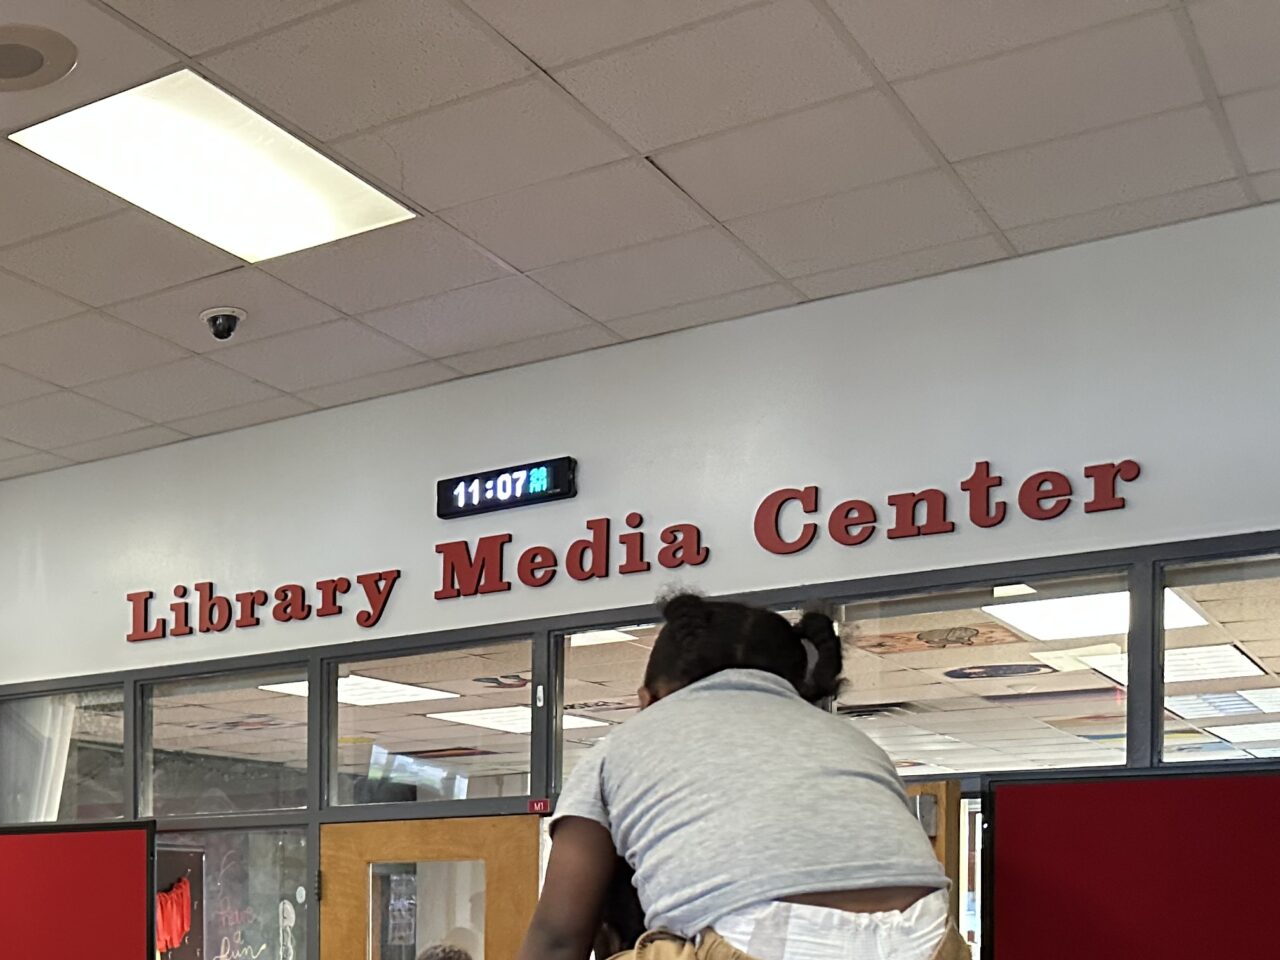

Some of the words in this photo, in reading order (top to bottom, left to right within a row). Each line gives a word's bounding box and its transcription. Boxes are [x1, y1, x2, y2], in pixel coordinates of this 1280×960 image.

[454, 470, 527, 508] 11:07
[127, 569, 401, 642] Library
[434, 512, 710, 600] Media
[753, 459, 1141, 555] Center
